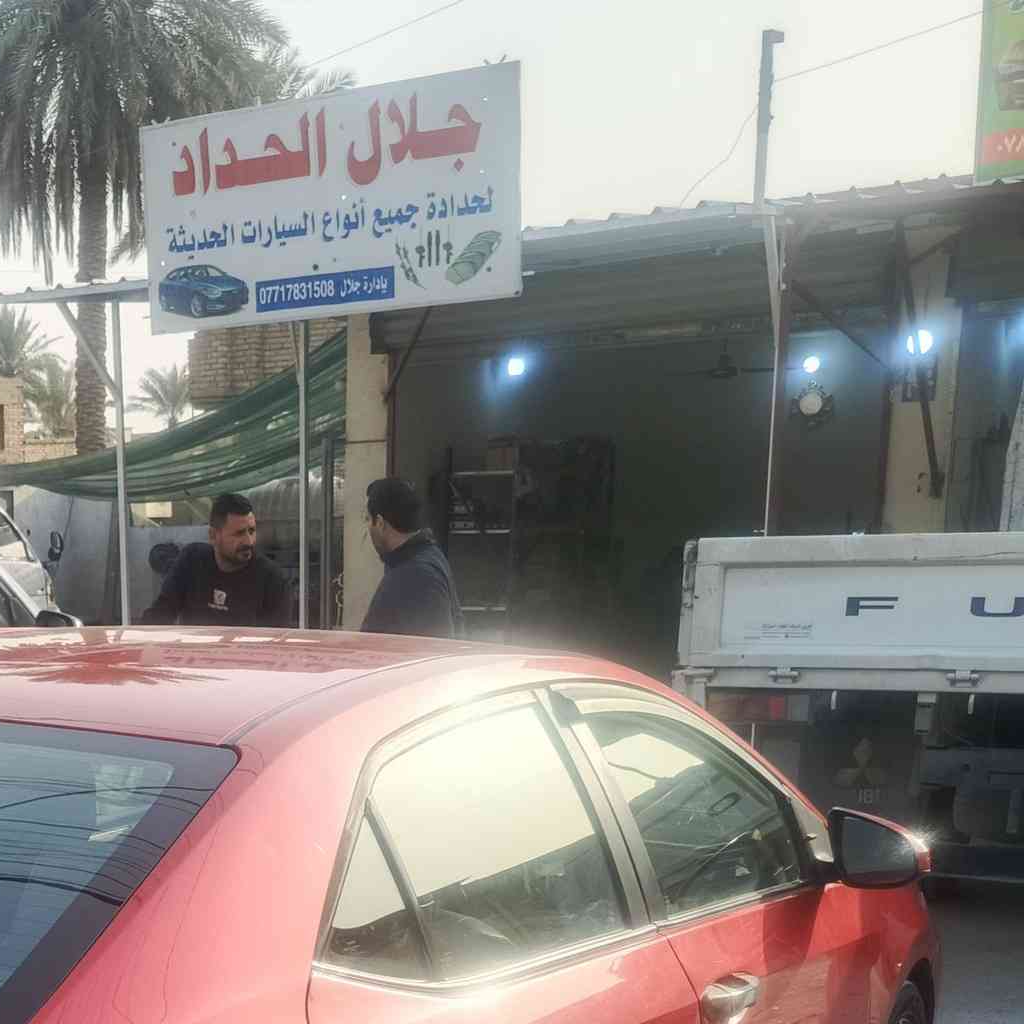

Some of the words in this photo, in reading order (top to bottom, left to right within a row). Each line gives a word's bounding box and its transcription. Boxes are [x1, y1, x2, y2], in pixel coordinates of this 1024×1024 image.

[171, 107, 328, 197] الحداد
[347, 91, 482, 186] جلال
[240, 212, 316, 248] السيارات
[372, 203, 419, 239] جميع
[166, 224, 236, 260] الحديثة
[258, 279, 335, 305] 07717831508
